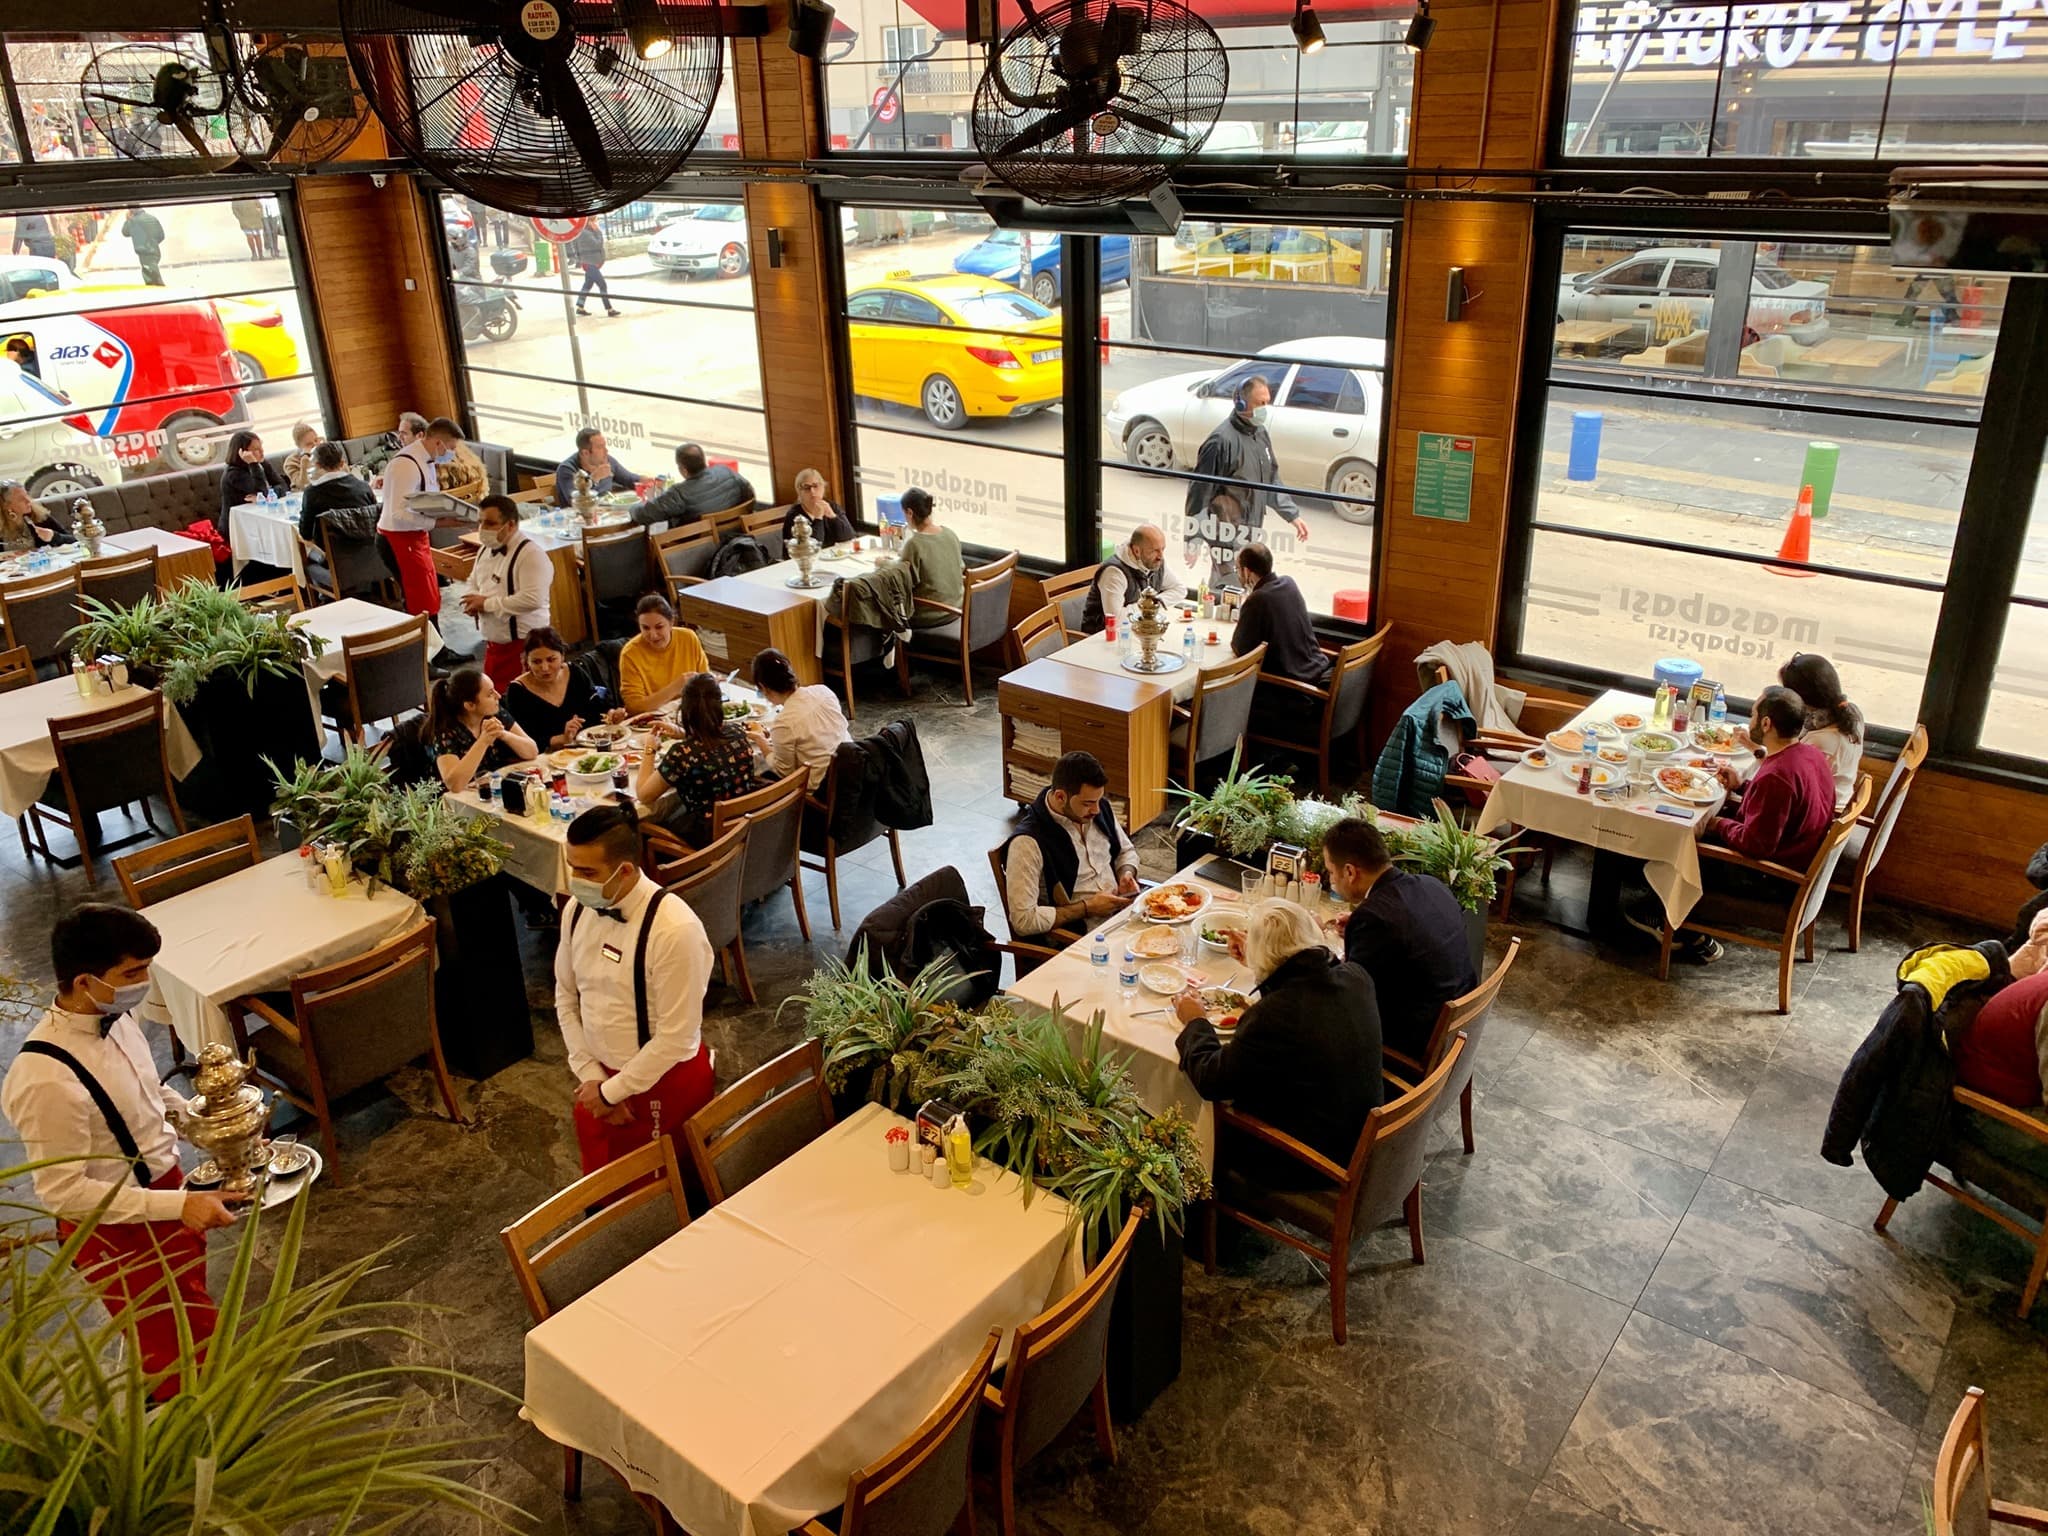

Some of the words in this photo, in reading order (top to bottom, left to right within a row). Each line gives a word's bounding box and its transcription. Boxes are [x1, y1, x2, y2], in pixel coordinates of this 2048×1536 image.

[1576, 0, 1851, 70] LÜYORUZ
[49, 344, 90, 360] aras
[1437, 437, 1453, 454] 14
[1274, 860, 1290, 870] 25
[923, 1126, 938, 1140] 27
